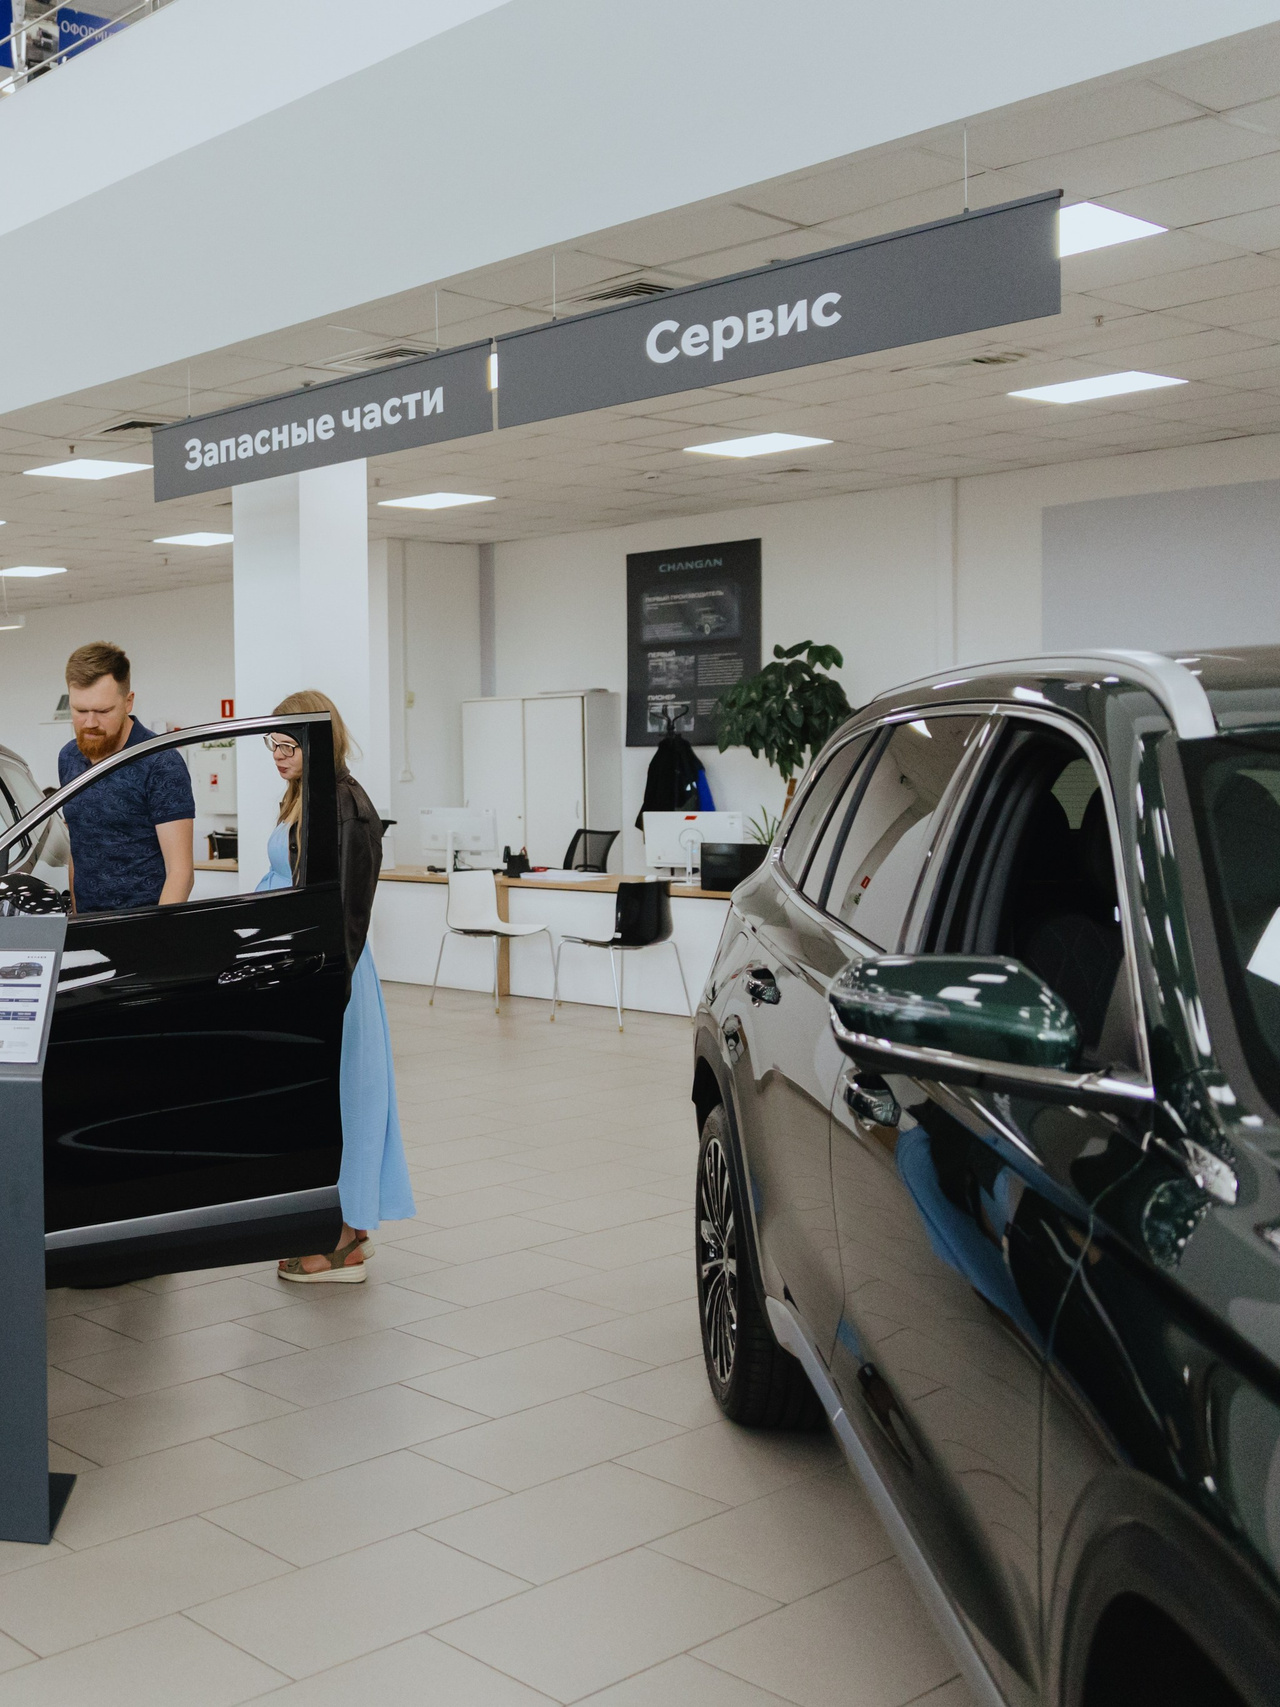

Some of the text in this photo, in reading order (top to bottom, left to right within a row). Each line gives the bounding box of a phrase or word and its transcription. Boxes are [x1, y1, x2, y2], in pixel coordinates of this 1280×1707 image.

[646, 292, 842, 364] Сервис
[184, 386, 444, 471] Запасные части
[659, 558, 723, 573] CHANGAN
[647, 693, 676, 701] ПИОНЕР
